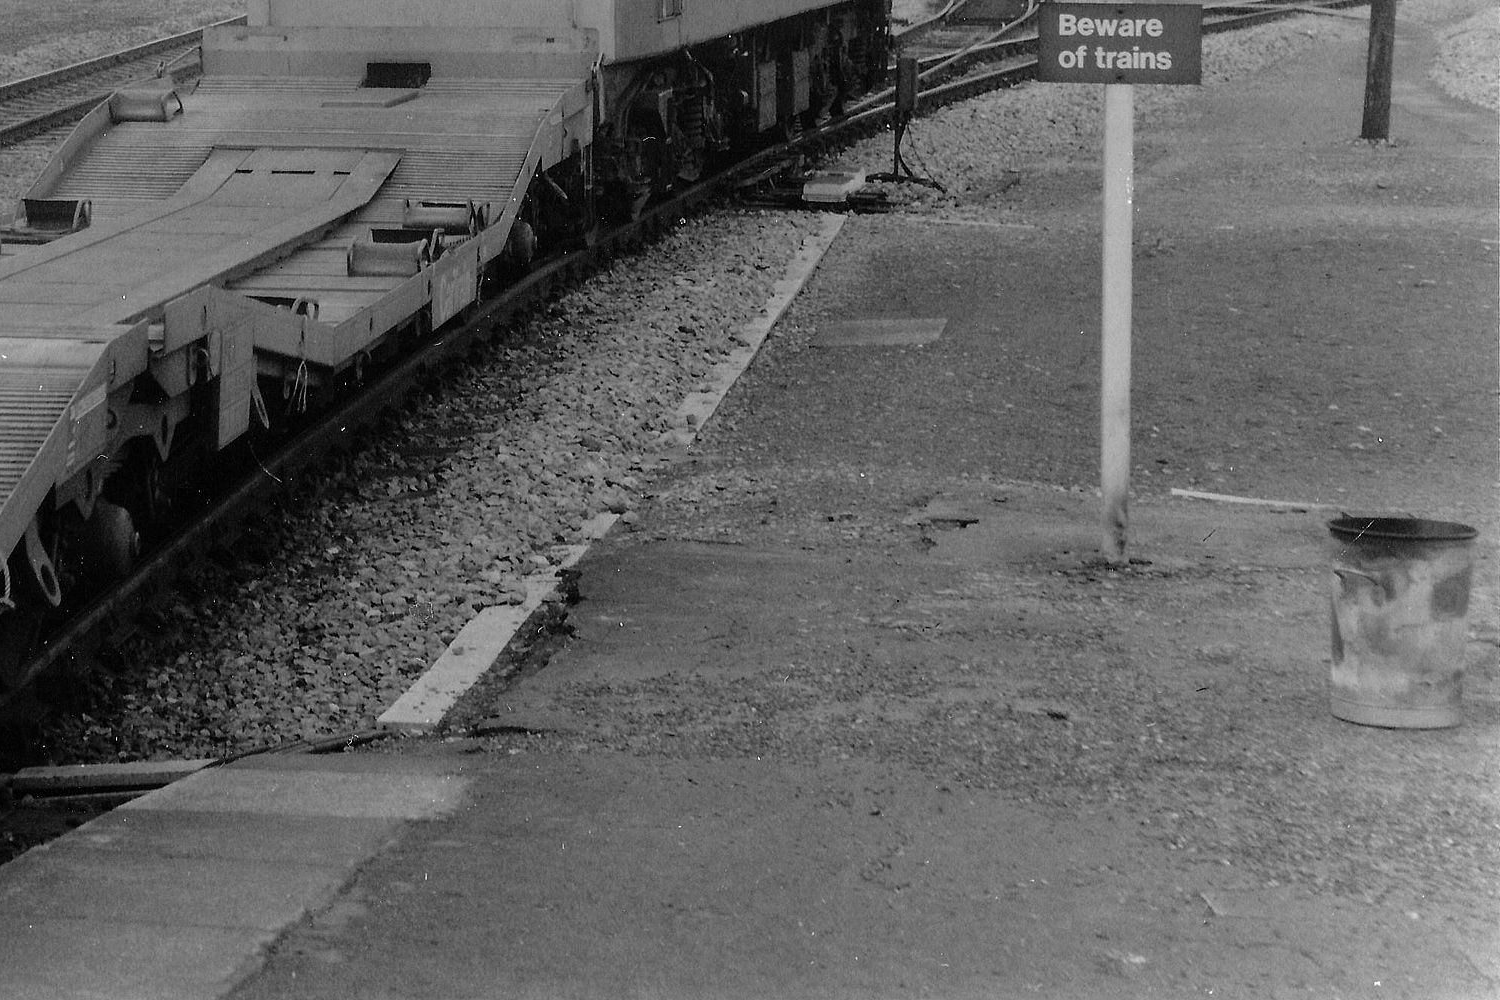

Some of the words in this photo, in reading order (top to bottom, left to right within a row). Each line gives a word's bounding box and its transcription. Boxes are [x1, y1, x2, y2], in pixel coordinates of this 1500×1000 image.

[1058, 13, 1164, 37] Beware
[1058, 45, 1088, 69] of
[1094, 46, 1173, 70] trains
